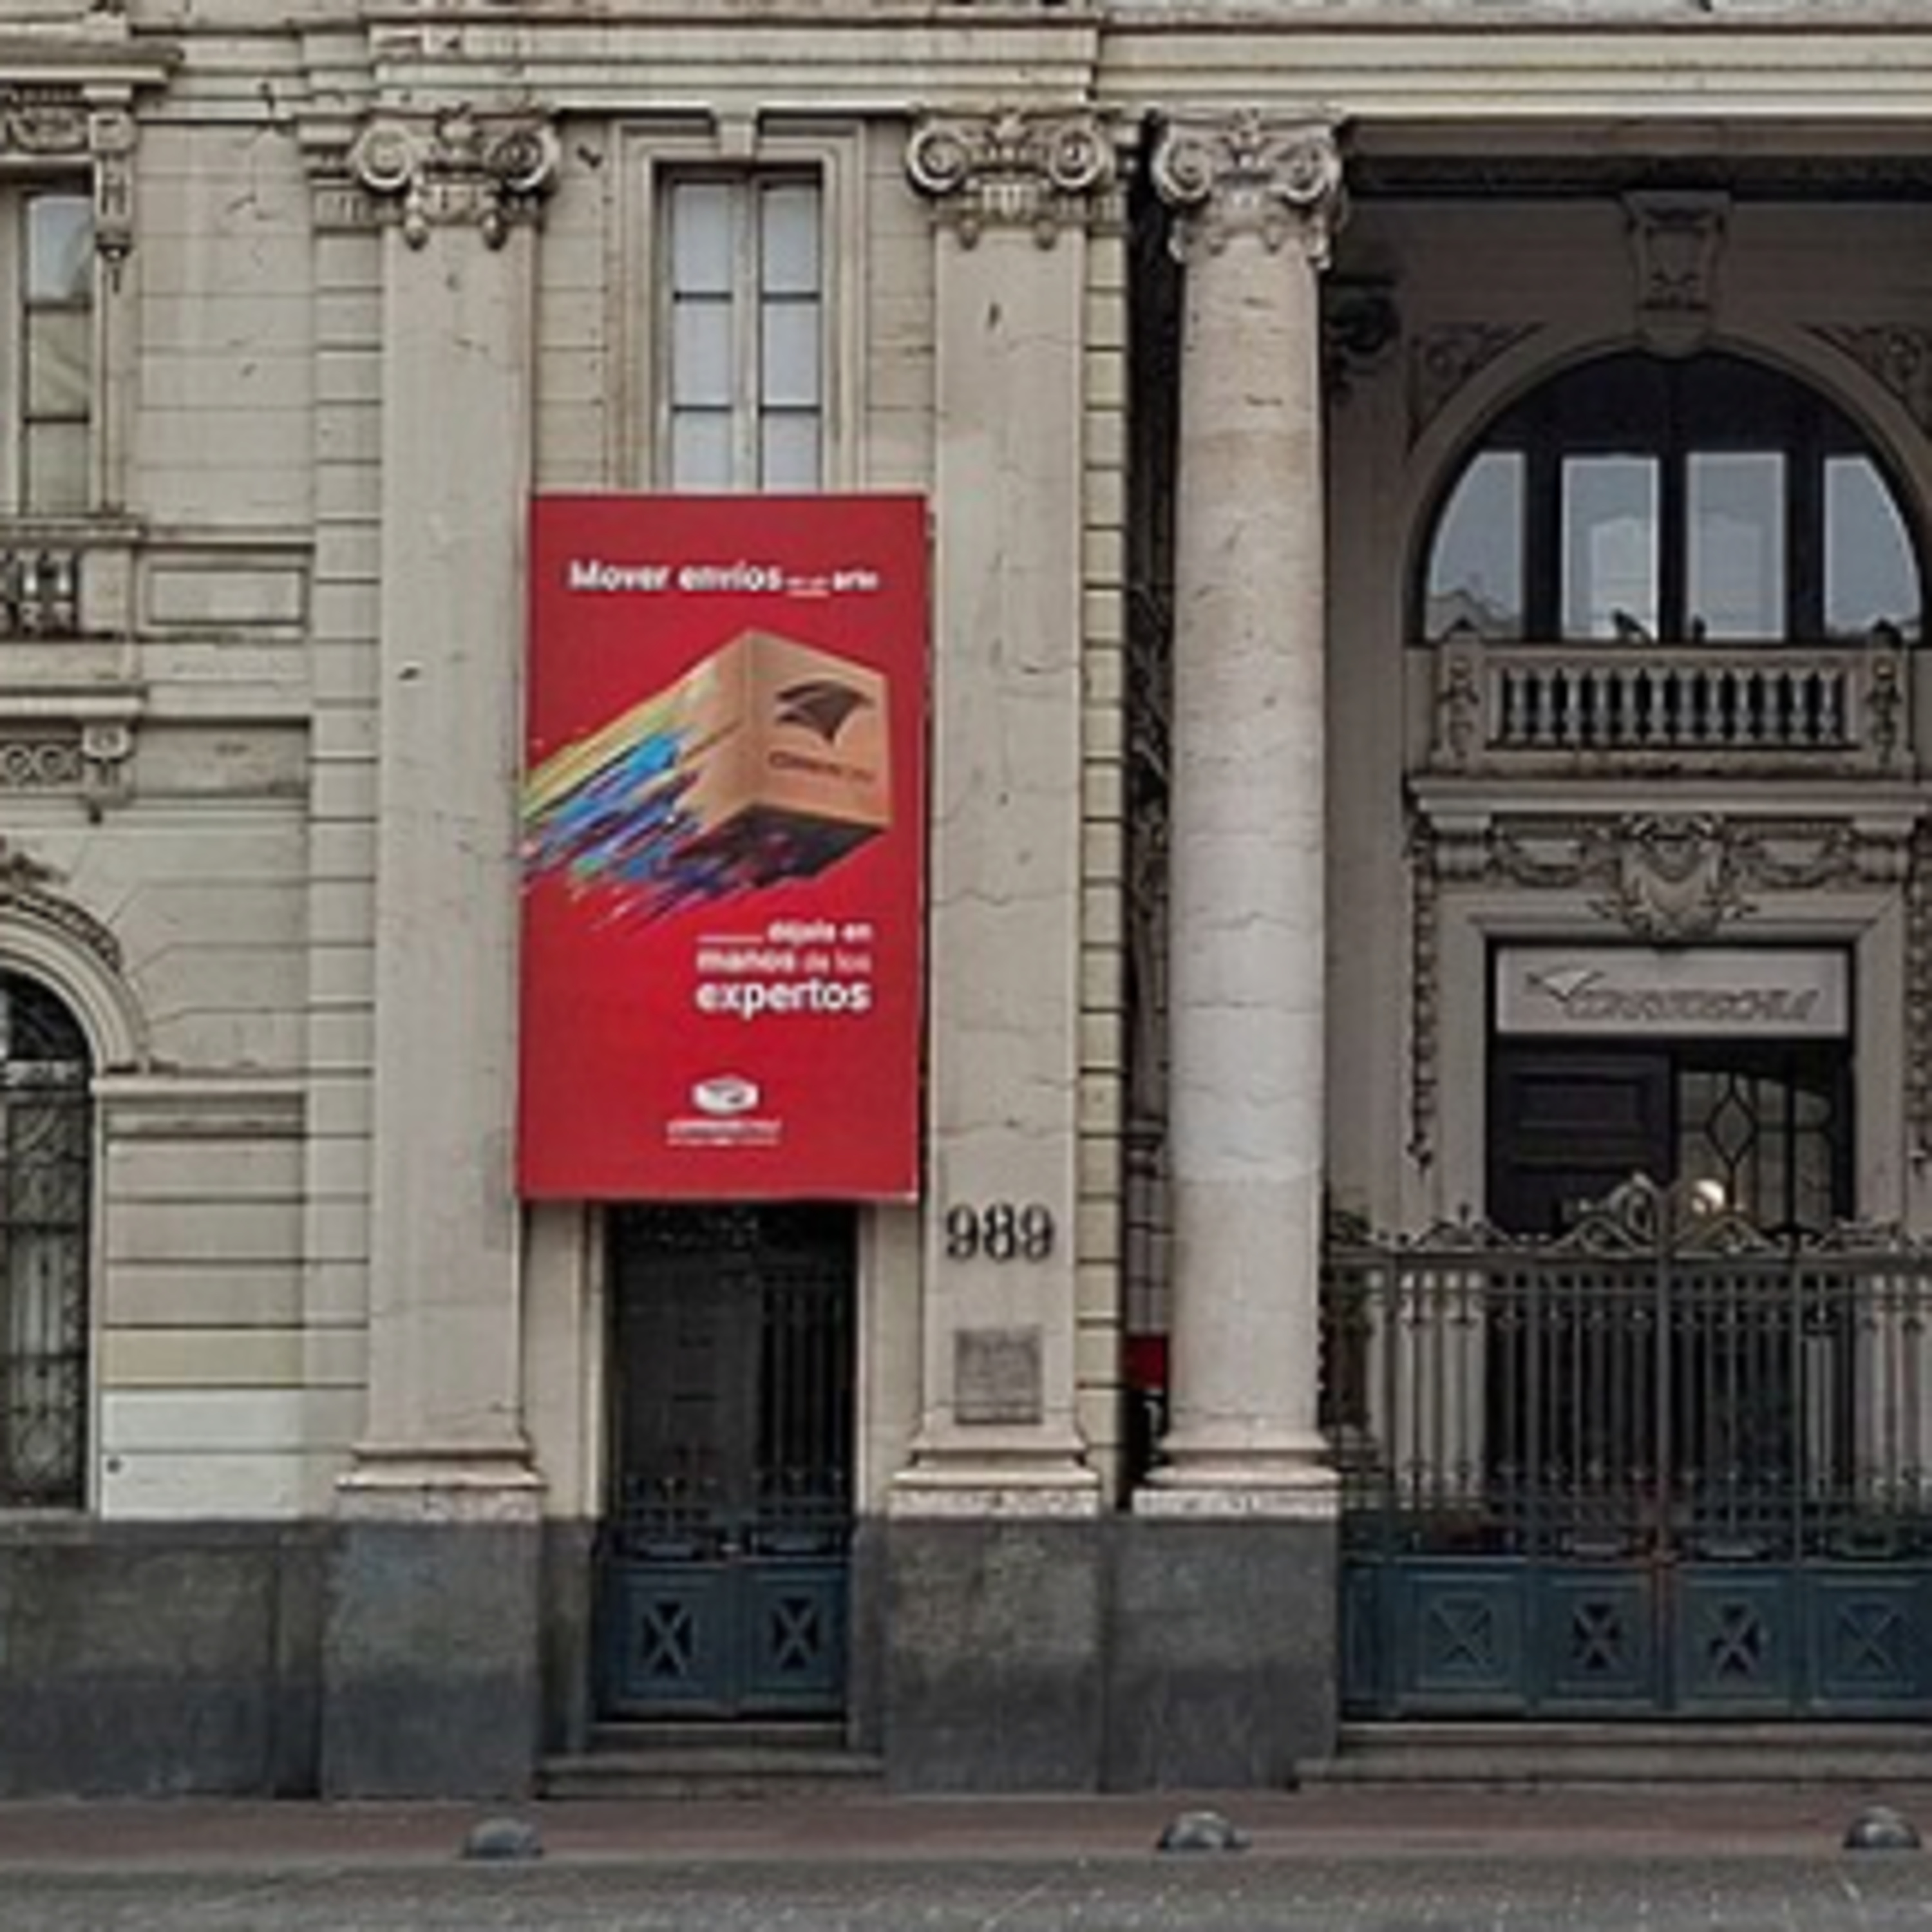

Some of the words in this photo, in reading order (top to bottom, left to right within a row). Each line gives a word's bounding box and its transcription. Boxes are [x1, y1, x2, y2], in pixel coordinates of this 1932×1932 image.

[569, 560, 670, 592] Mover
[679, 559, 782, 592] envíos
[696, 950, 795, 974] manos
[696, 978, 872, 1021] expertos
[945, 1203, 1055, 1264] 989
